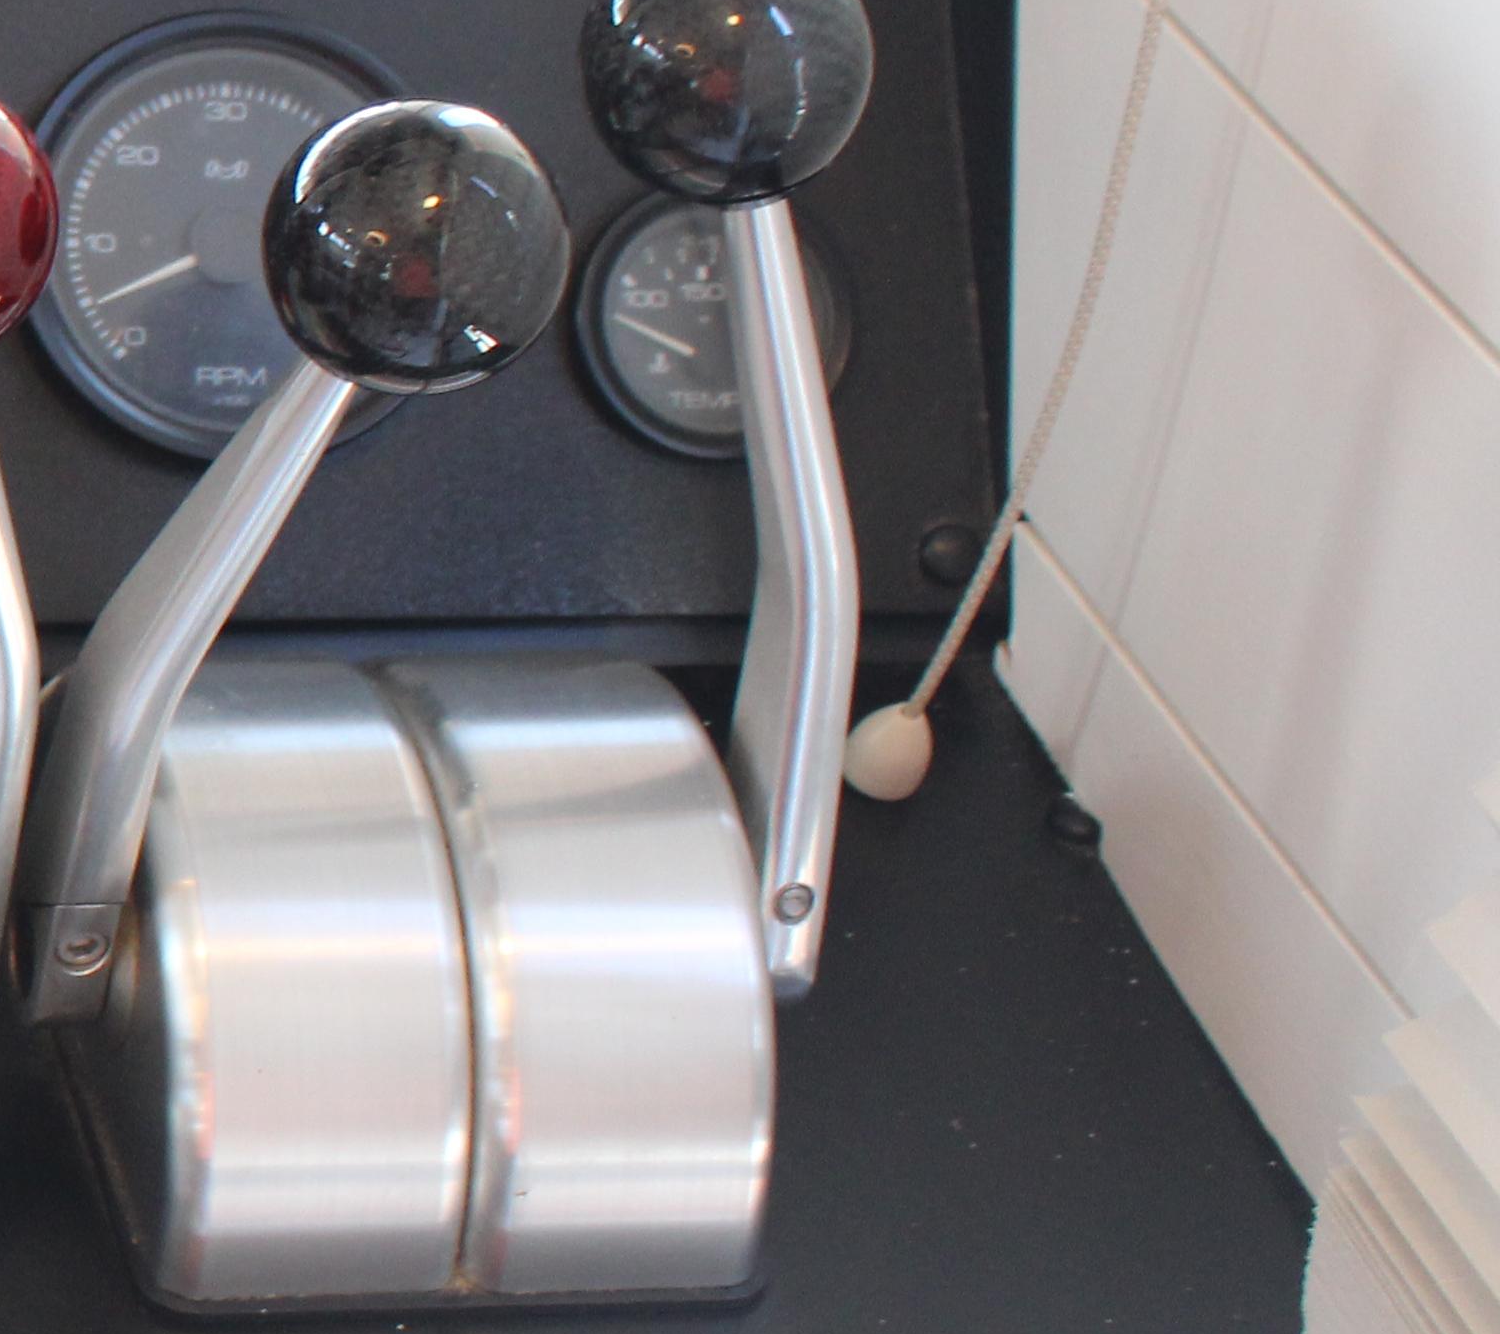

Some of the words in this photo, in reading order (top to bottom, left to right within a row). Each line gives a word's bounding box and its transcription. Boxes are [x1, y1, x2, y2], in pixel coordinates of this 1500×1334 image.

[204, 102, 249, 123] 30
[116, 145, 160, 166] 20
[125, 327, 147, 347] 0
[195, 367, 267, 387] RPM
